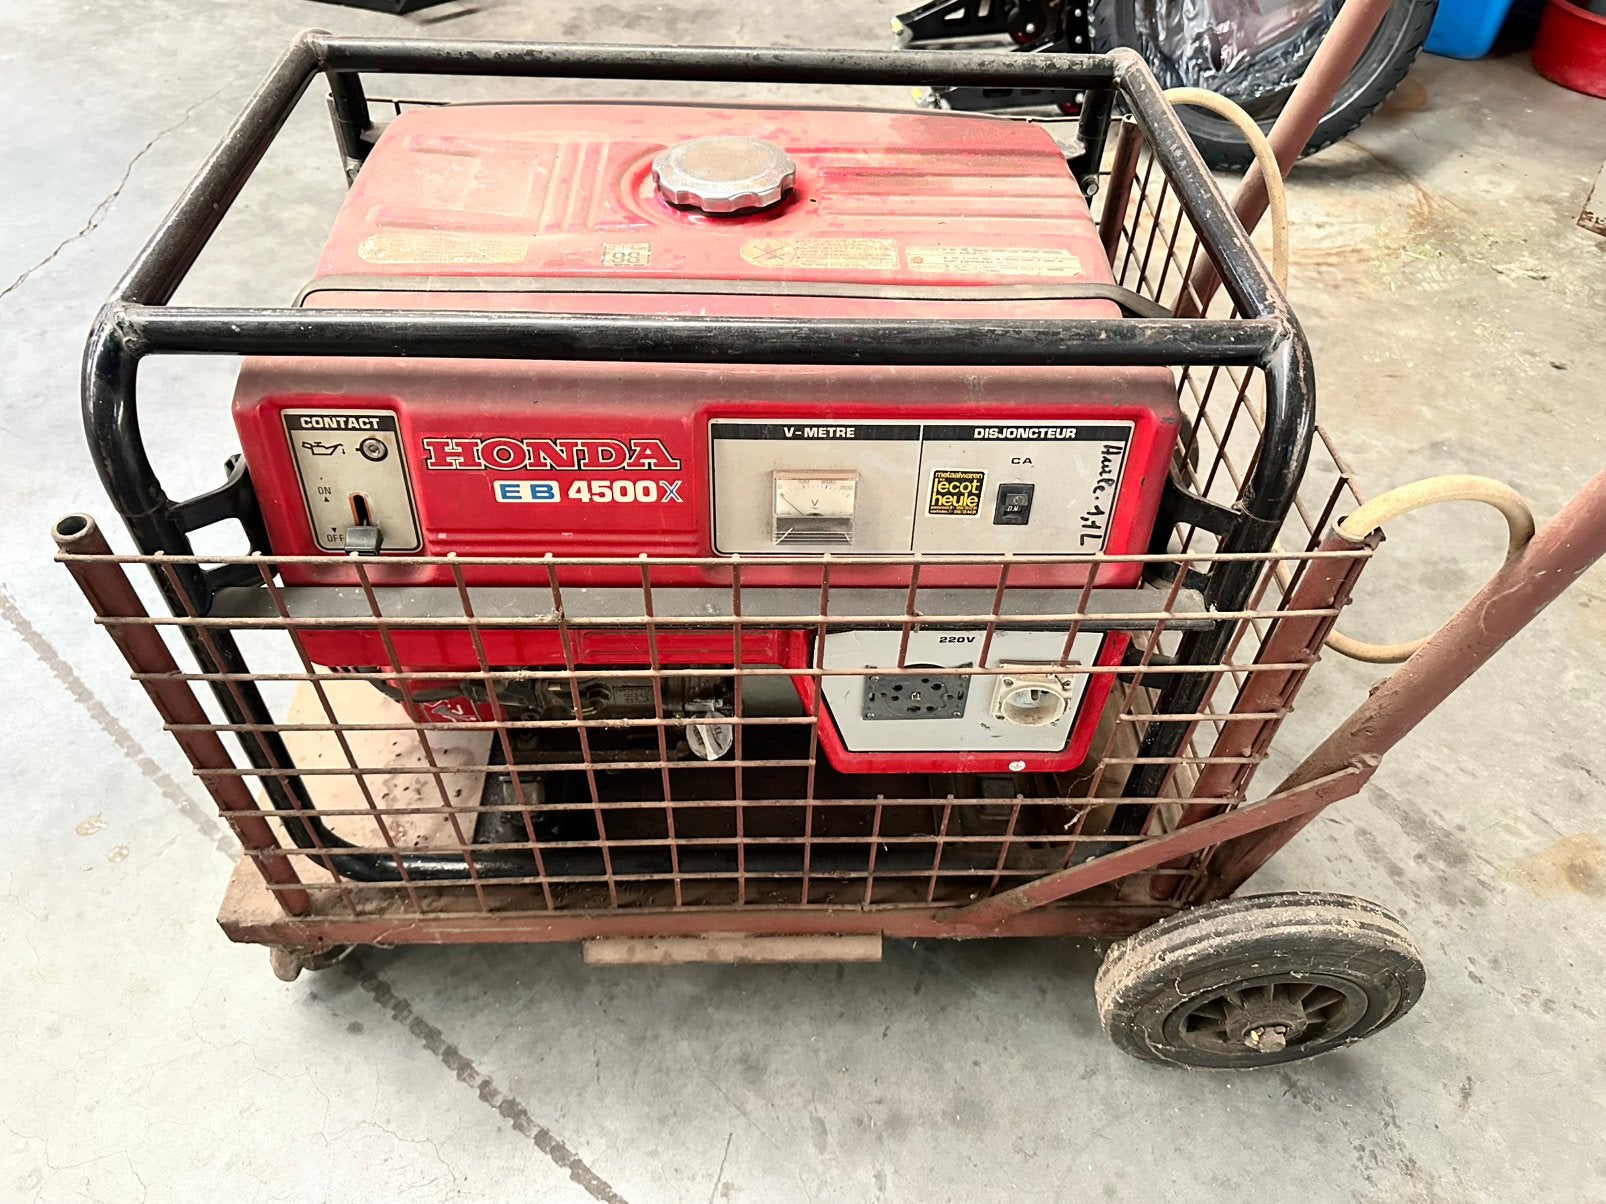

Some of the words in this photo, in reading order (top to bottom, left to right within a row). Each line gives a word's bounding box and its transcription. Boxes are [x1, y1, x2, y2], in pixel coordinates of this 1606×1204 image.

[300, 416, 380, 430] CONTACT
[783, 427, 856, 438] V-METRE
[973, 427, 1077, 439] DISJONCTEUR
[422, 437, 682, 471] HONDA
[1011, 457, 1033, 465] CA
[317, 486, 332, 495] ON
[498, 481, 557, 501] EB
[568, 480, 684, 502] 4500X
[933, 478, 980, 494] lecot
[931, 492, 979, 507] heule
[326, 533, 345, 543] OFF
[939, 635, 976, 644] 220V
